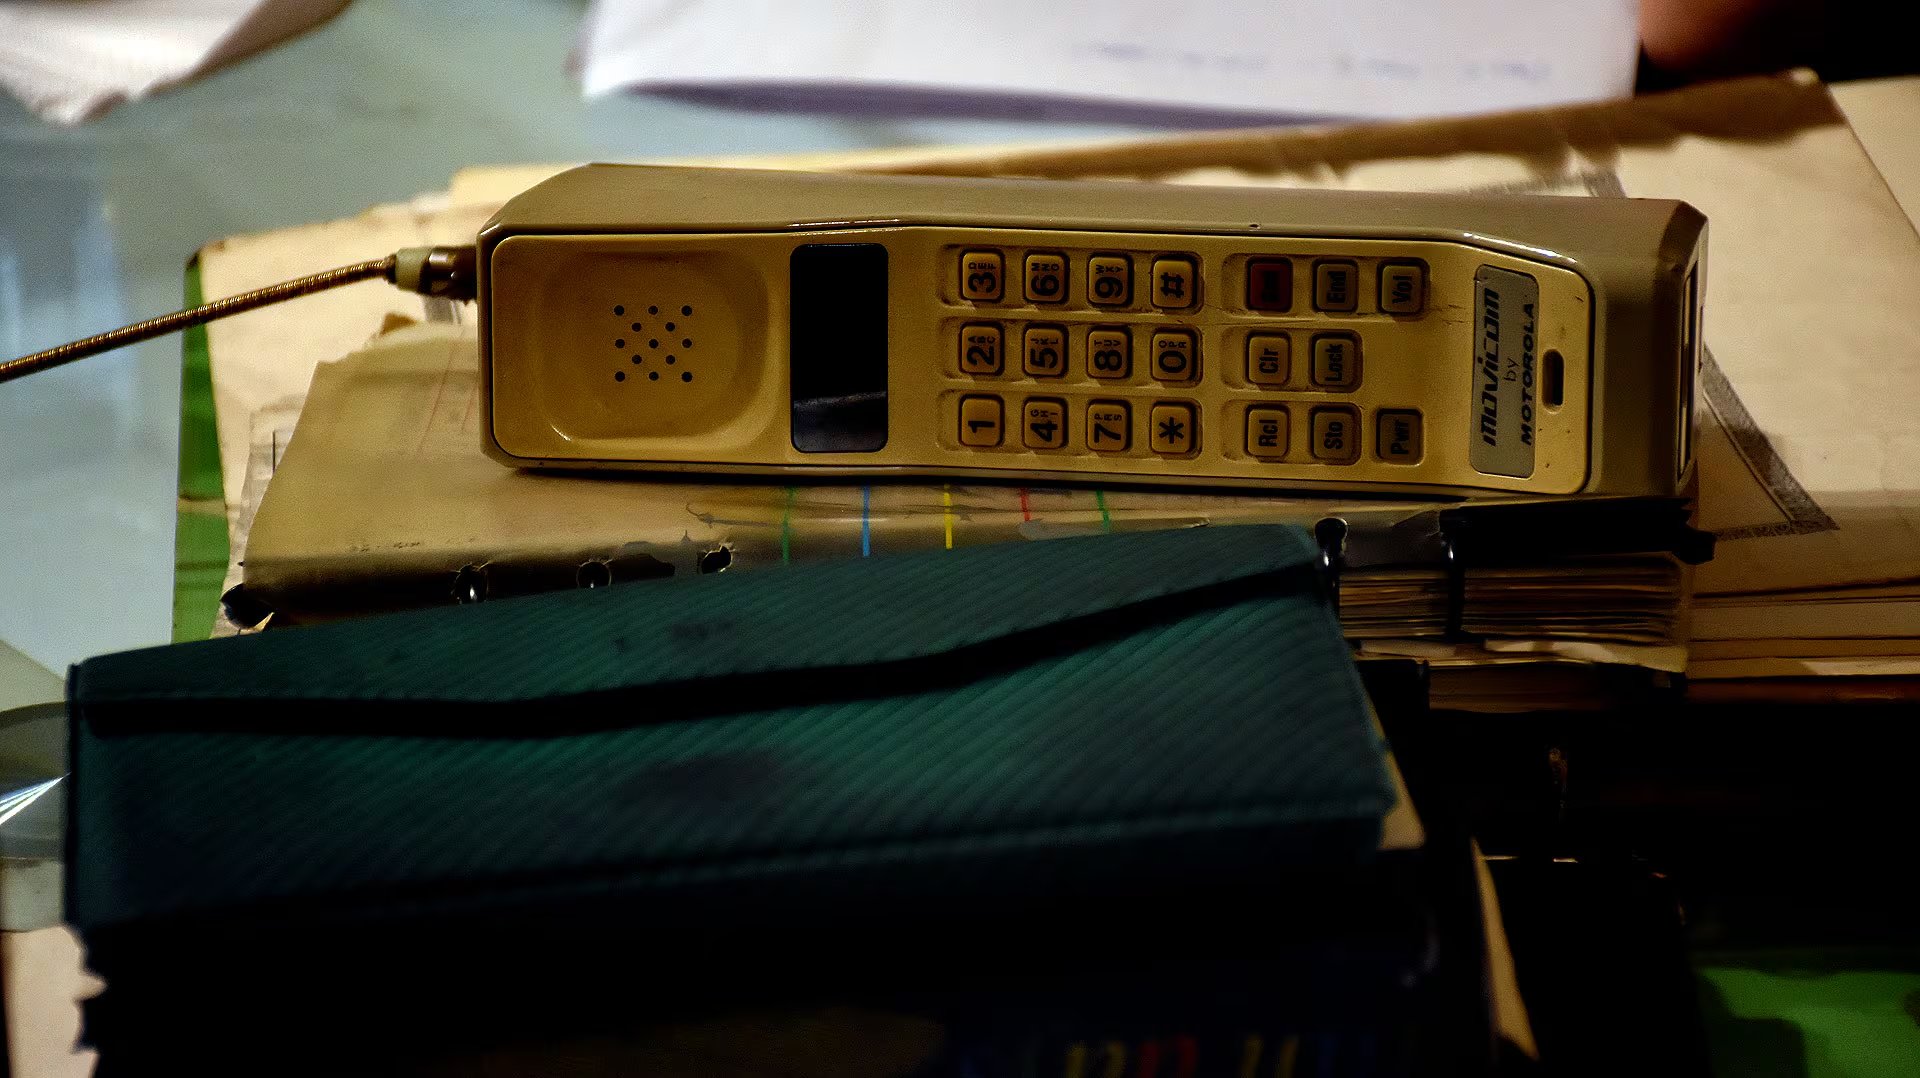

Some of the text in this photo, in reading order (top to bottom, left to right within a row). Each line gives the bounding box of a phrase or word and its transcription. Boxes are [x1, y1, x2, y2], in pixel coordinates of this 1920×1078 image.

[968, 272, 996, 293] 3
[1031, 274, 1059, 296] 6
[1094, 276, 1123, 298] 9
[1160, 271, 1185, 298] #
[1392, 275, 1412, 304] Vol
[966, 346, 995, 366] 2
[1030, 348, 1059, 369] 5
[1094, 349, 1123, 371] 8
[1259, 348, 1279, 374] Clr
[1325, 343, 1344, 382] Lock
[1504, 357, 1519, 382] by
[1520, 303, 1535, 446] MOTOROLA
[968, 420, 995, 433] 1
[1030, 420, 1058, 442] 4
[1094, 423, 1122, 443] 7
[1258, 419, 1278, 447] Rcl
[1324, 421, 1344, 450] Sto
